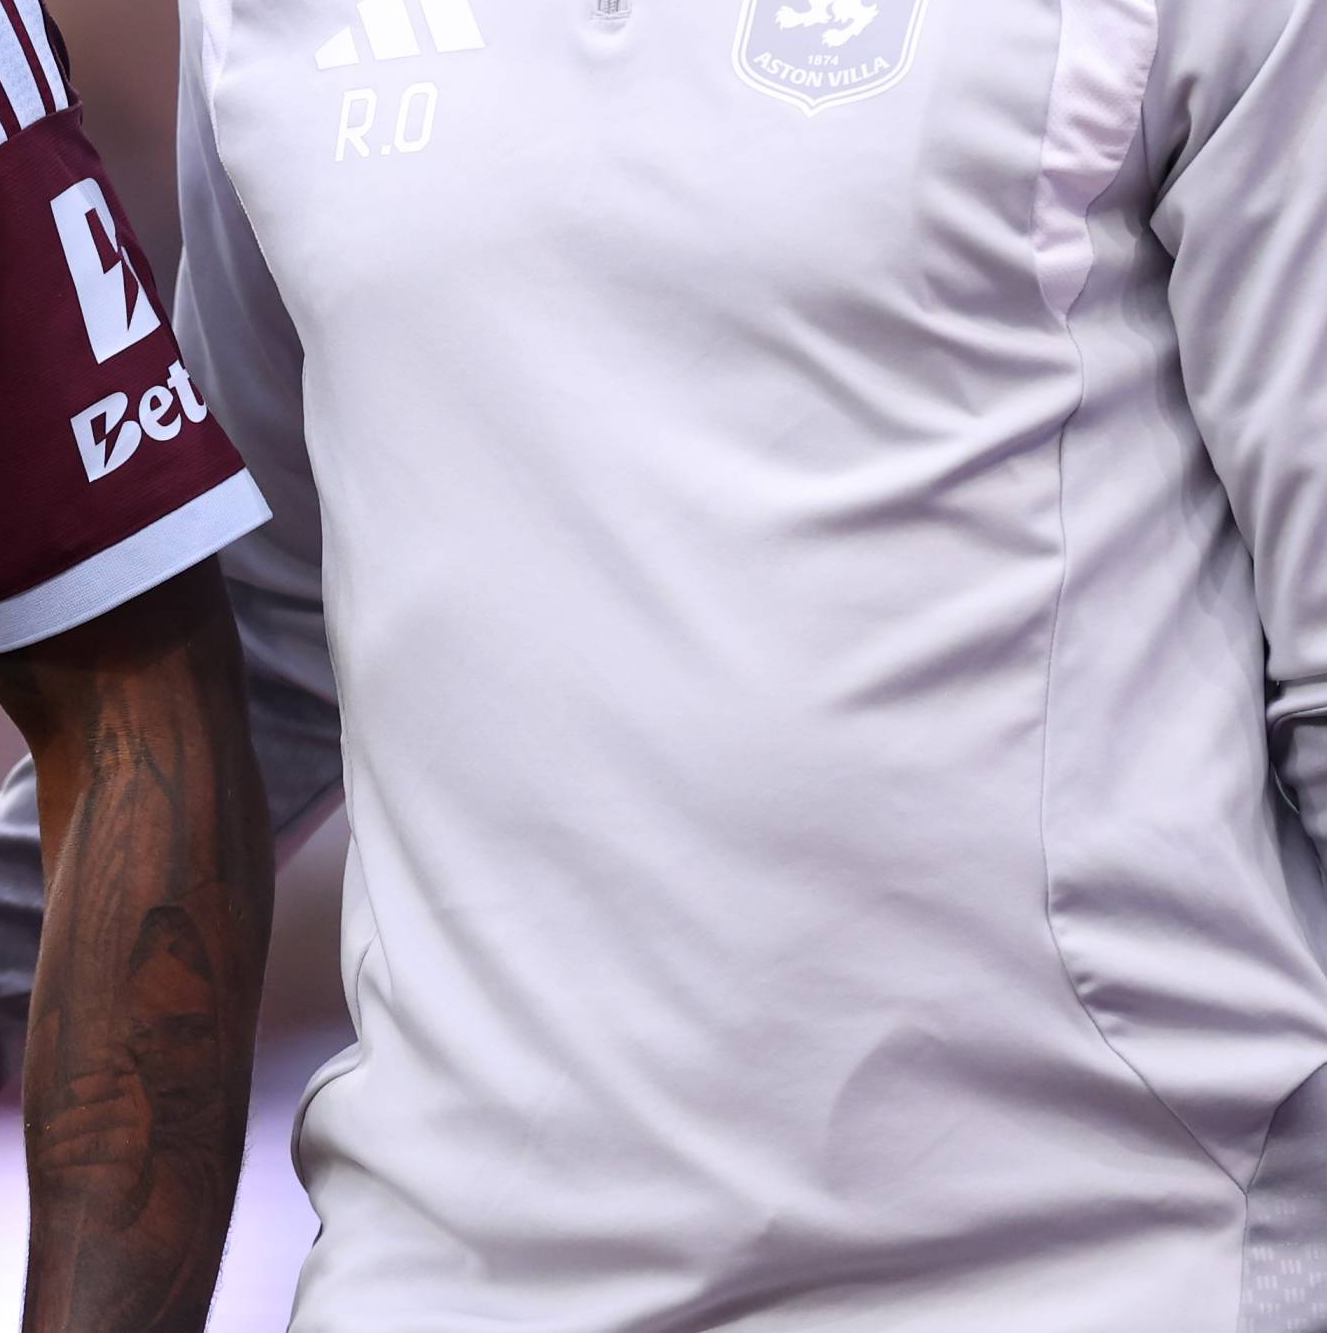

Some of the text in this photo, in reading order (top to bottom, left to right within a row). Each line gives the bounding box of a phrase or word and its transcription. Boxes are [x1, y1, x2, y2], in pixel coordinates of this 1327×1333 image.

[753, 52, 890, 87] ASTON VILLA
[807, 54, 840, 66] 1874
